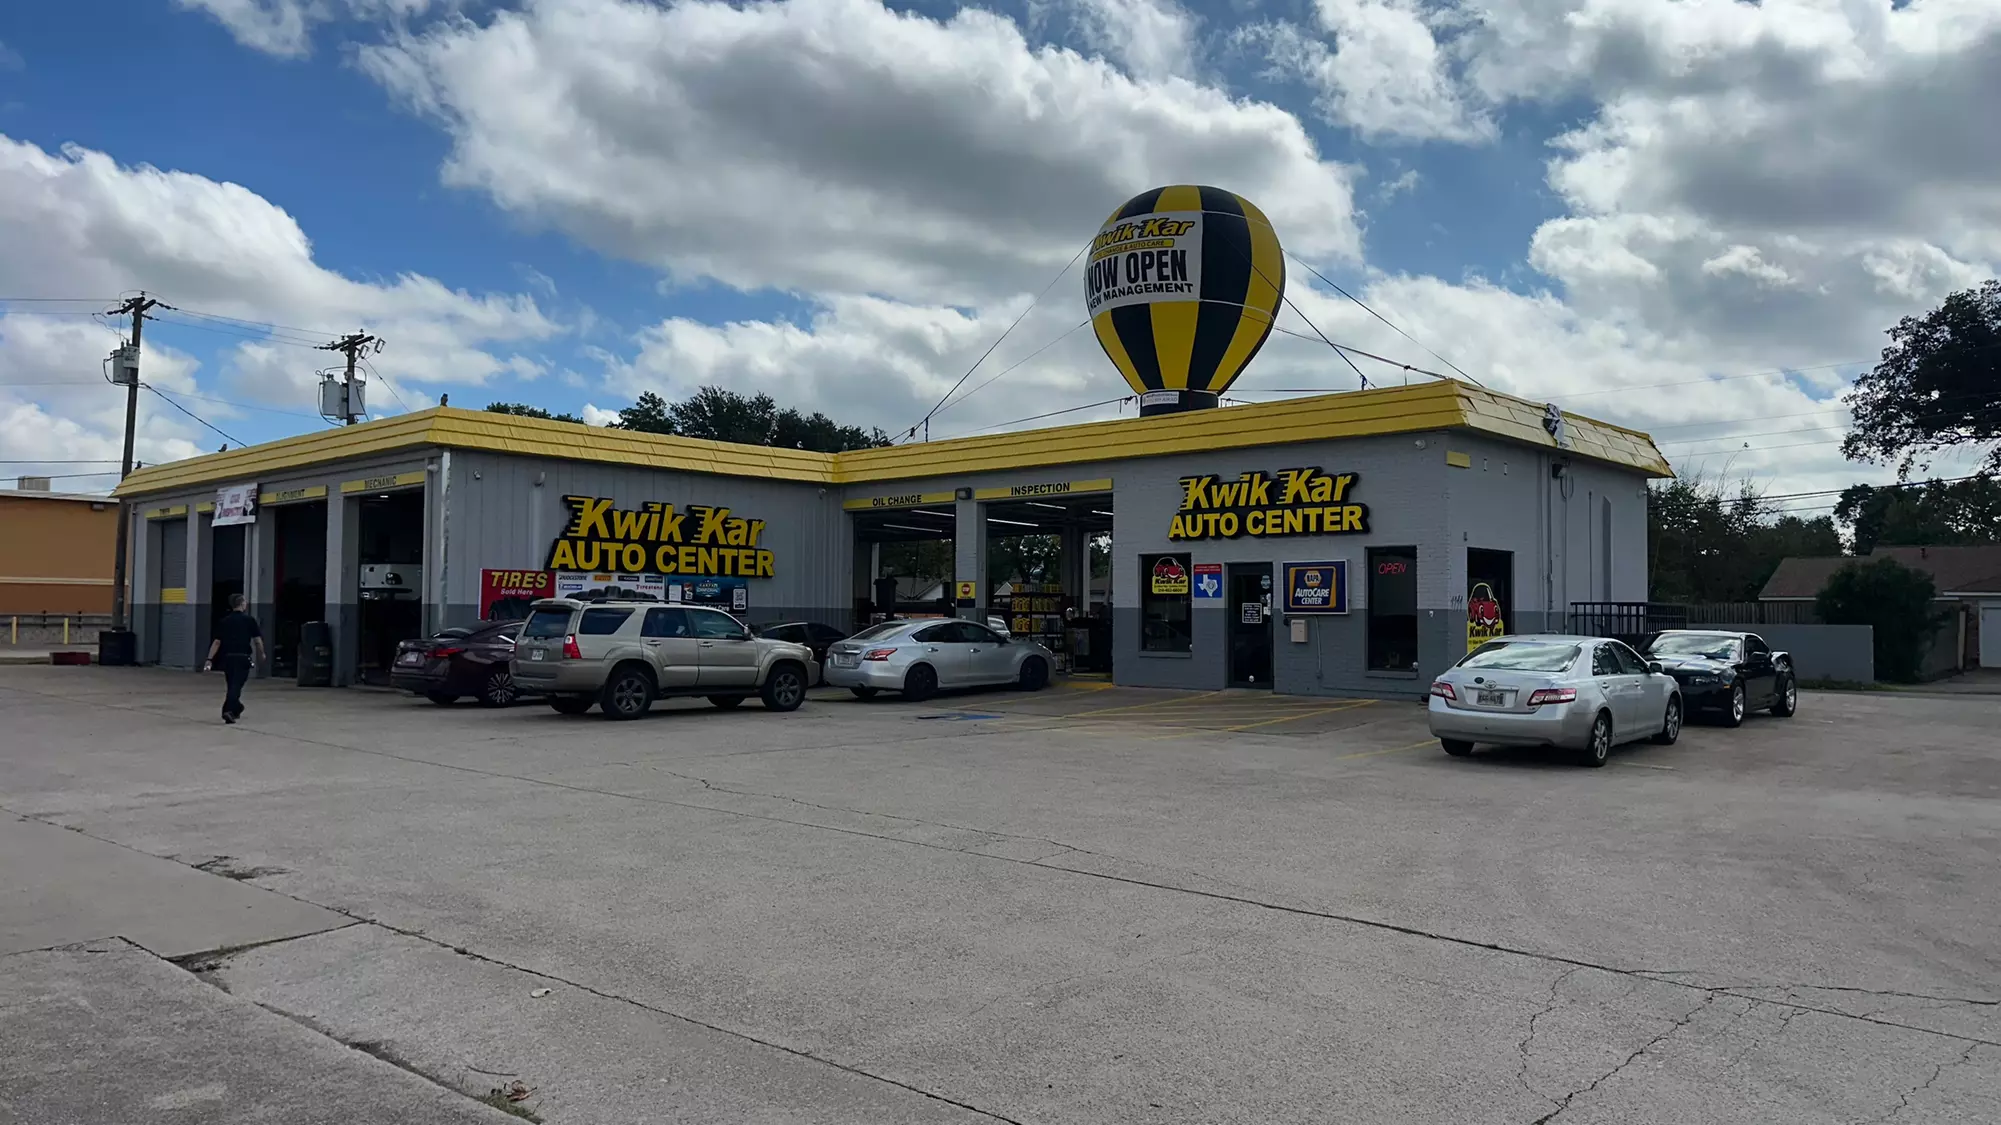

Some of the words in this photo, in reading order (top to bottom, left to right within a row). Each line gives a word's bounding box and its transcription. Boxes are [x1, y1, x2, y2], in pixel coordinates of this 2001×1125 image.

[1093, 222, 1138, 251] Kwik
[1139, 217, 1195, 239] Kar
[1128, 242, 1146, 251] AUTO
[1146, 240, 1165, 248] CARE
[1088, 255, 1119, 299] NOW
[1126, 249, 1188, 284] OPEN
[1090, 293, 1106, 310] NEW
[1105, 283, 1194, 301] MANAGEMENT
[364, 476, 397, 489] MECHANIC
[1010, 482, 1070, 496] INSPECTION
[1179, 473, 1272, 511] Kwik
[1276, 468, 1353, 505] Kar
[872, 498, 886, 507] OIL
[887, 494, 922, 506] CHANGE
[567, 496, 687, 543] Kwik
[691, 506, 766, 547] Kar
[1168, 513, 1239, 538] AUTO
[1246, 505, 1363, 536] CENTER
[550, 539, 647, 571] AUTO
[655, 545, 774, 577] CENTER
[1378, 562, 1407, 575] OPEN
[491, 571, 548, 589] TIRES
[519, 588, 533, 596] Here
[1301, 597, 1323, 605] CENTER
[1469, 625, 1488, 638] Kwik
[1489, 626, 1502, 637] Kar
